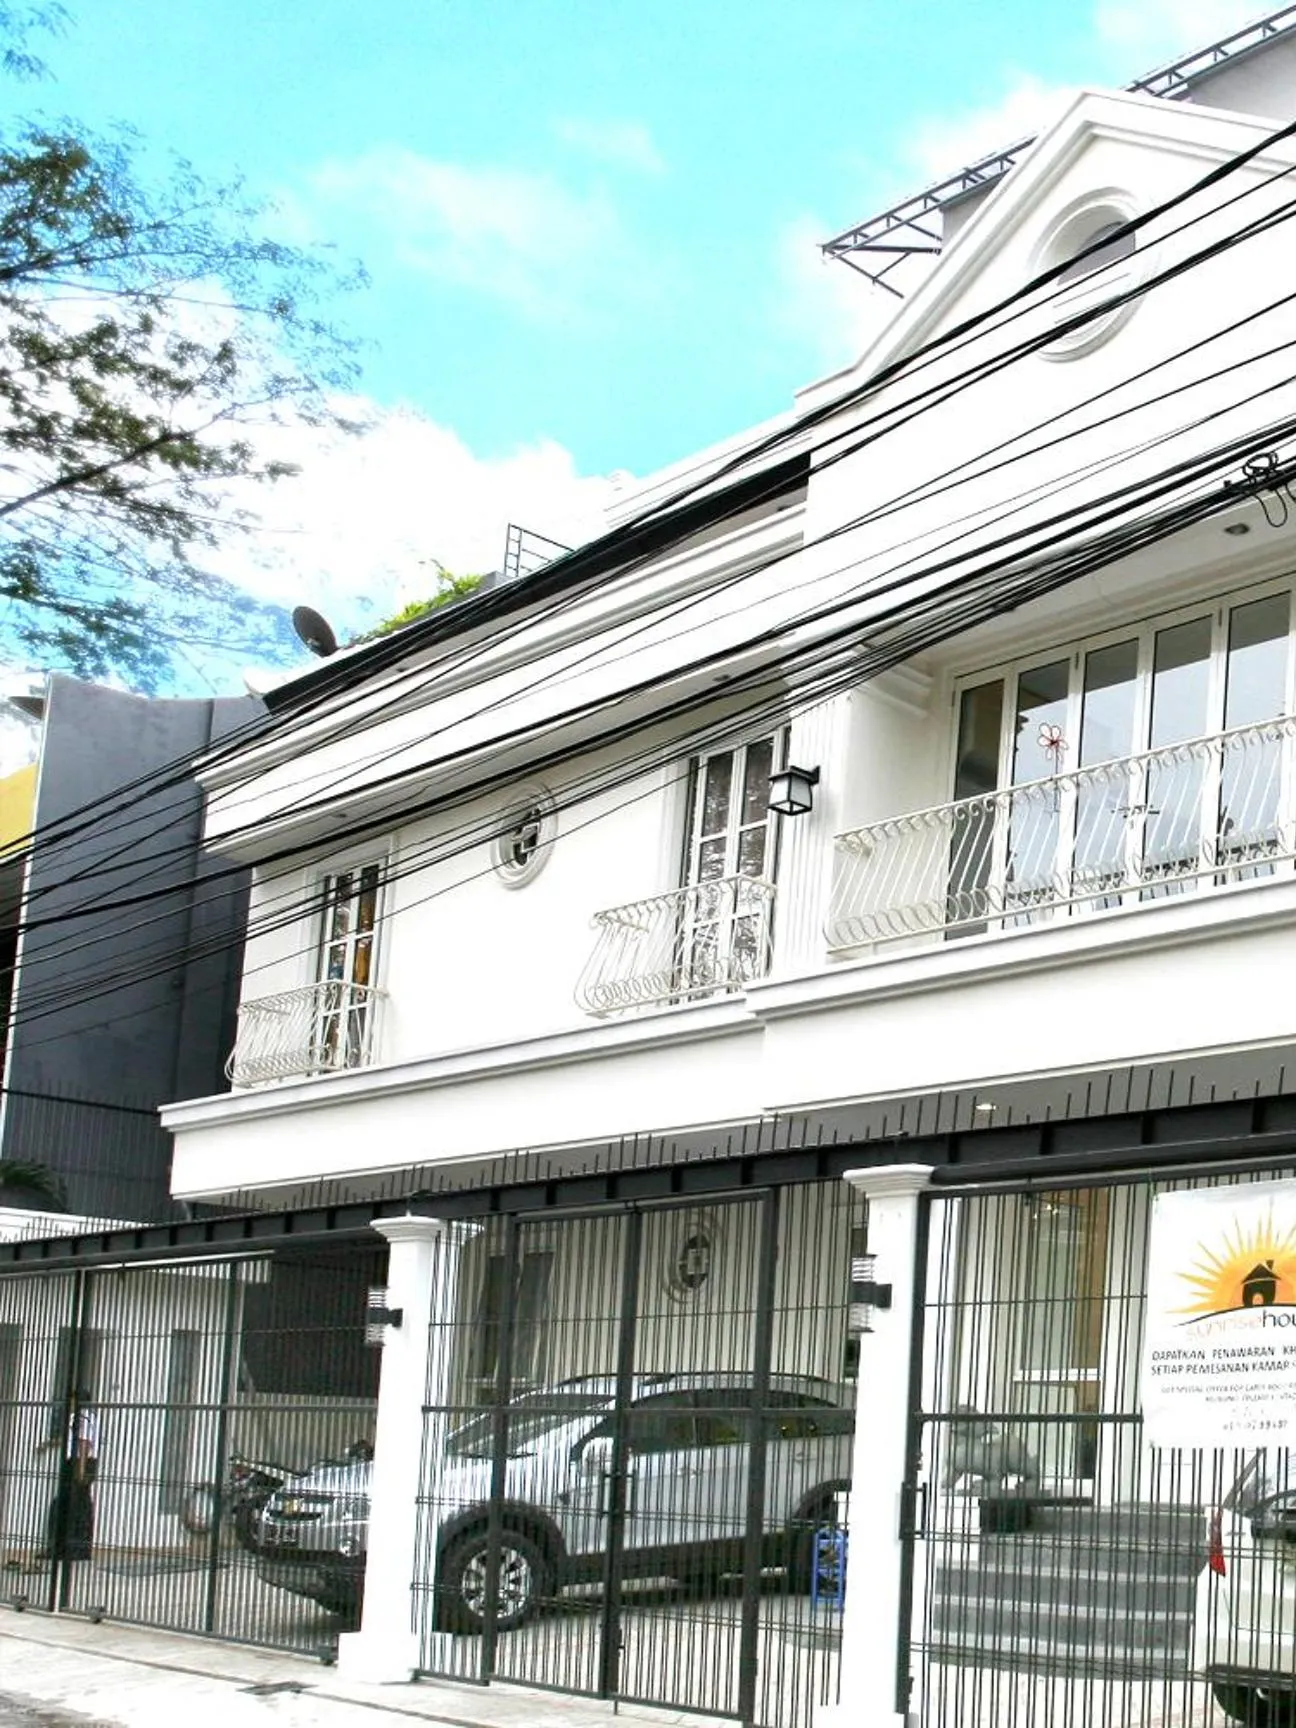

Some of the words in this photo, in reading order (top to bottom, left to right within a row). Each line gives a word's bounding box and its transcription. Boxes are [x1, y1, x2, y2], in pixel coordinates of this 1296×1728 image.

[1152, 1349, 1206, 1361] DAPATKAN
[1212, 1346, 1275, 1359] PENAWARAN
[1151, 1363, 1185, 1376] SETIAP
[1186, 1361, 1250, 1375] PEMESANAN
